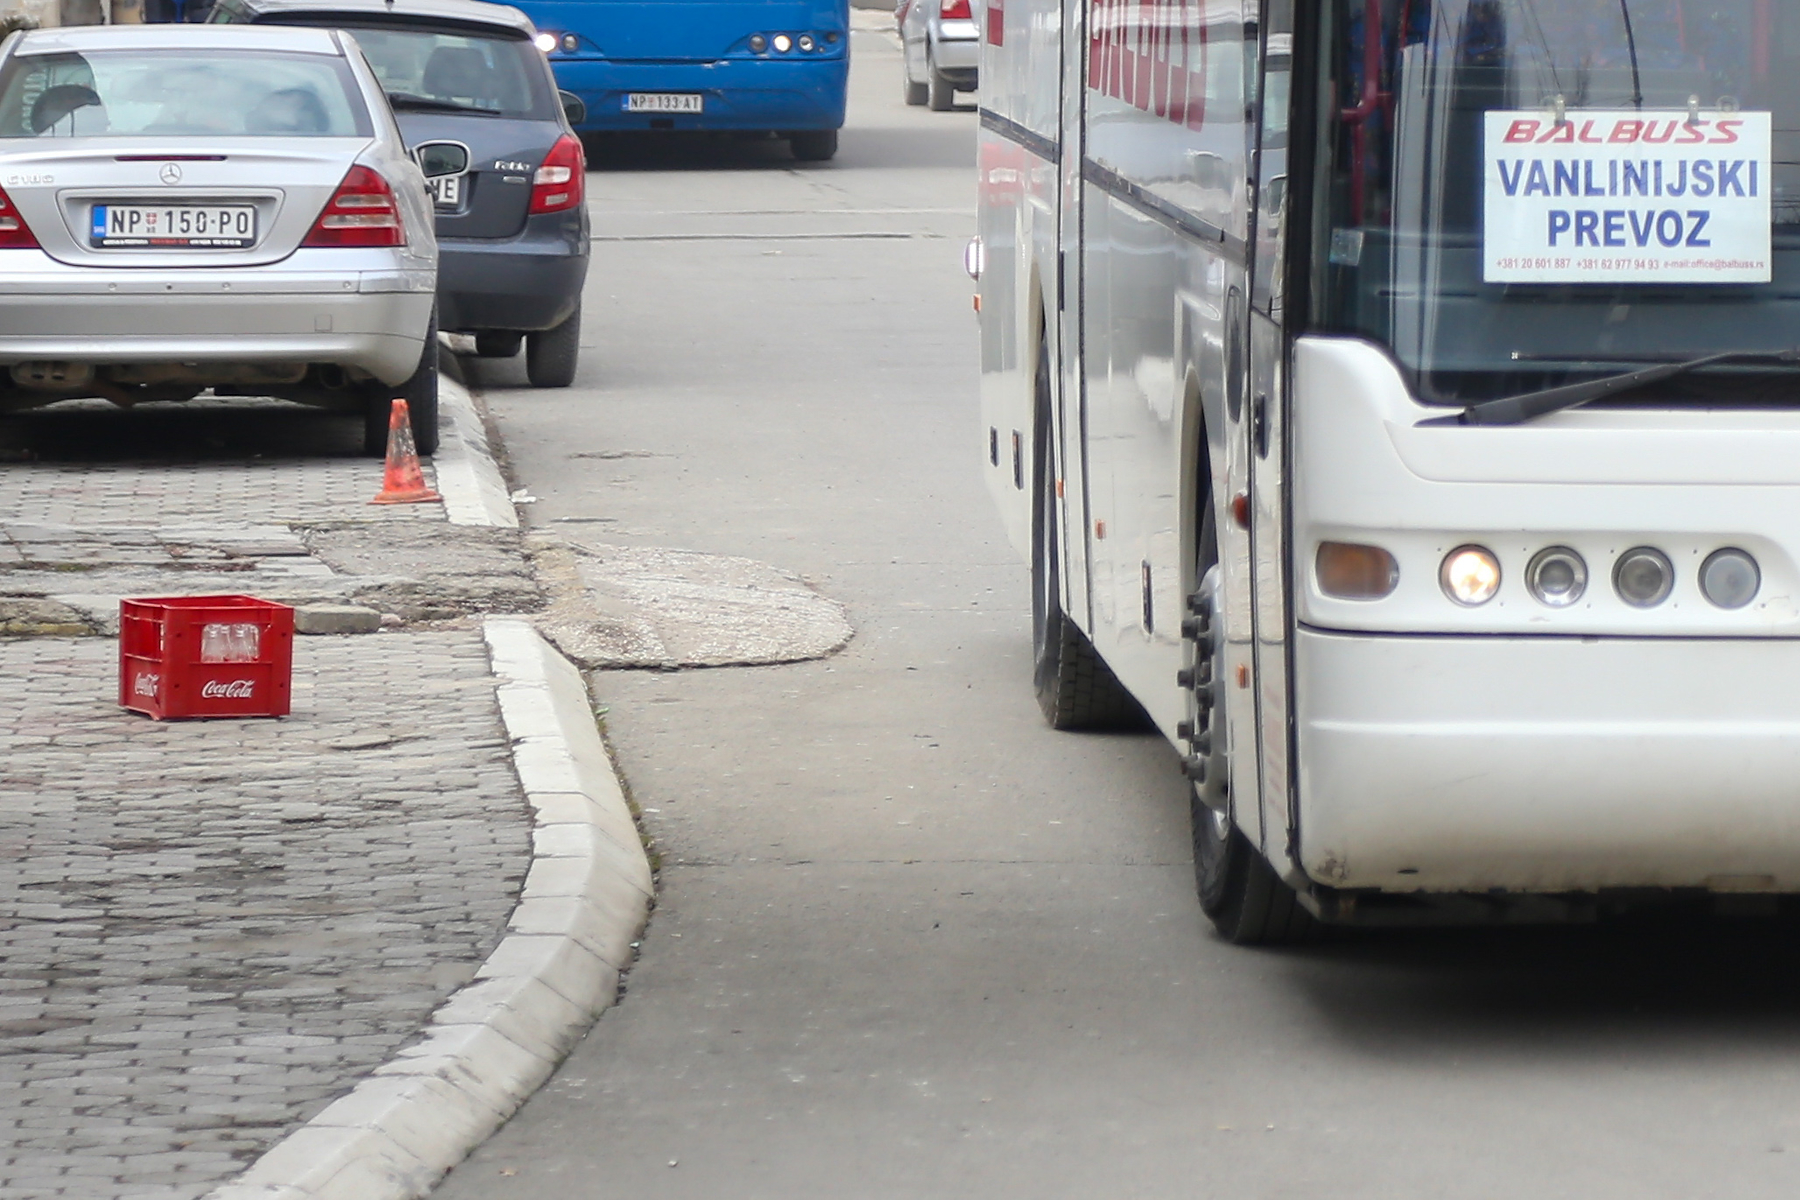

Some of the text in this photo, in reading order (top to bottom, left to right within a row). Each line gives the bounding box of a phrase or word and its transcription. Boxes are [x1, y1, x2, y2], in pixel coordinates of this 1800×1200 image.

[630, 95, 646, 108] NP
[1502, 120, 1744, 144] BALBUSS
[1497, 159, 1758, 197] VANLINIJSKI
[111, 210, 141, 233] NP
[1548, 210, 1711, 247] PREVOZ
[1496, 258, 1518, 269] +381
[1521, 258, 1532, 269] 20
[1535, 258, 1551, 269] 601
[1555, 258, 1571, 269] 887
[1577, 259, 1598, 270] +381
[1601, 259, 1612, 270] 62
[1615, 259, 1631, 270] 977
[1634, 259, 1646, 270] 94
[1648, 259, 1659, 270] 93
